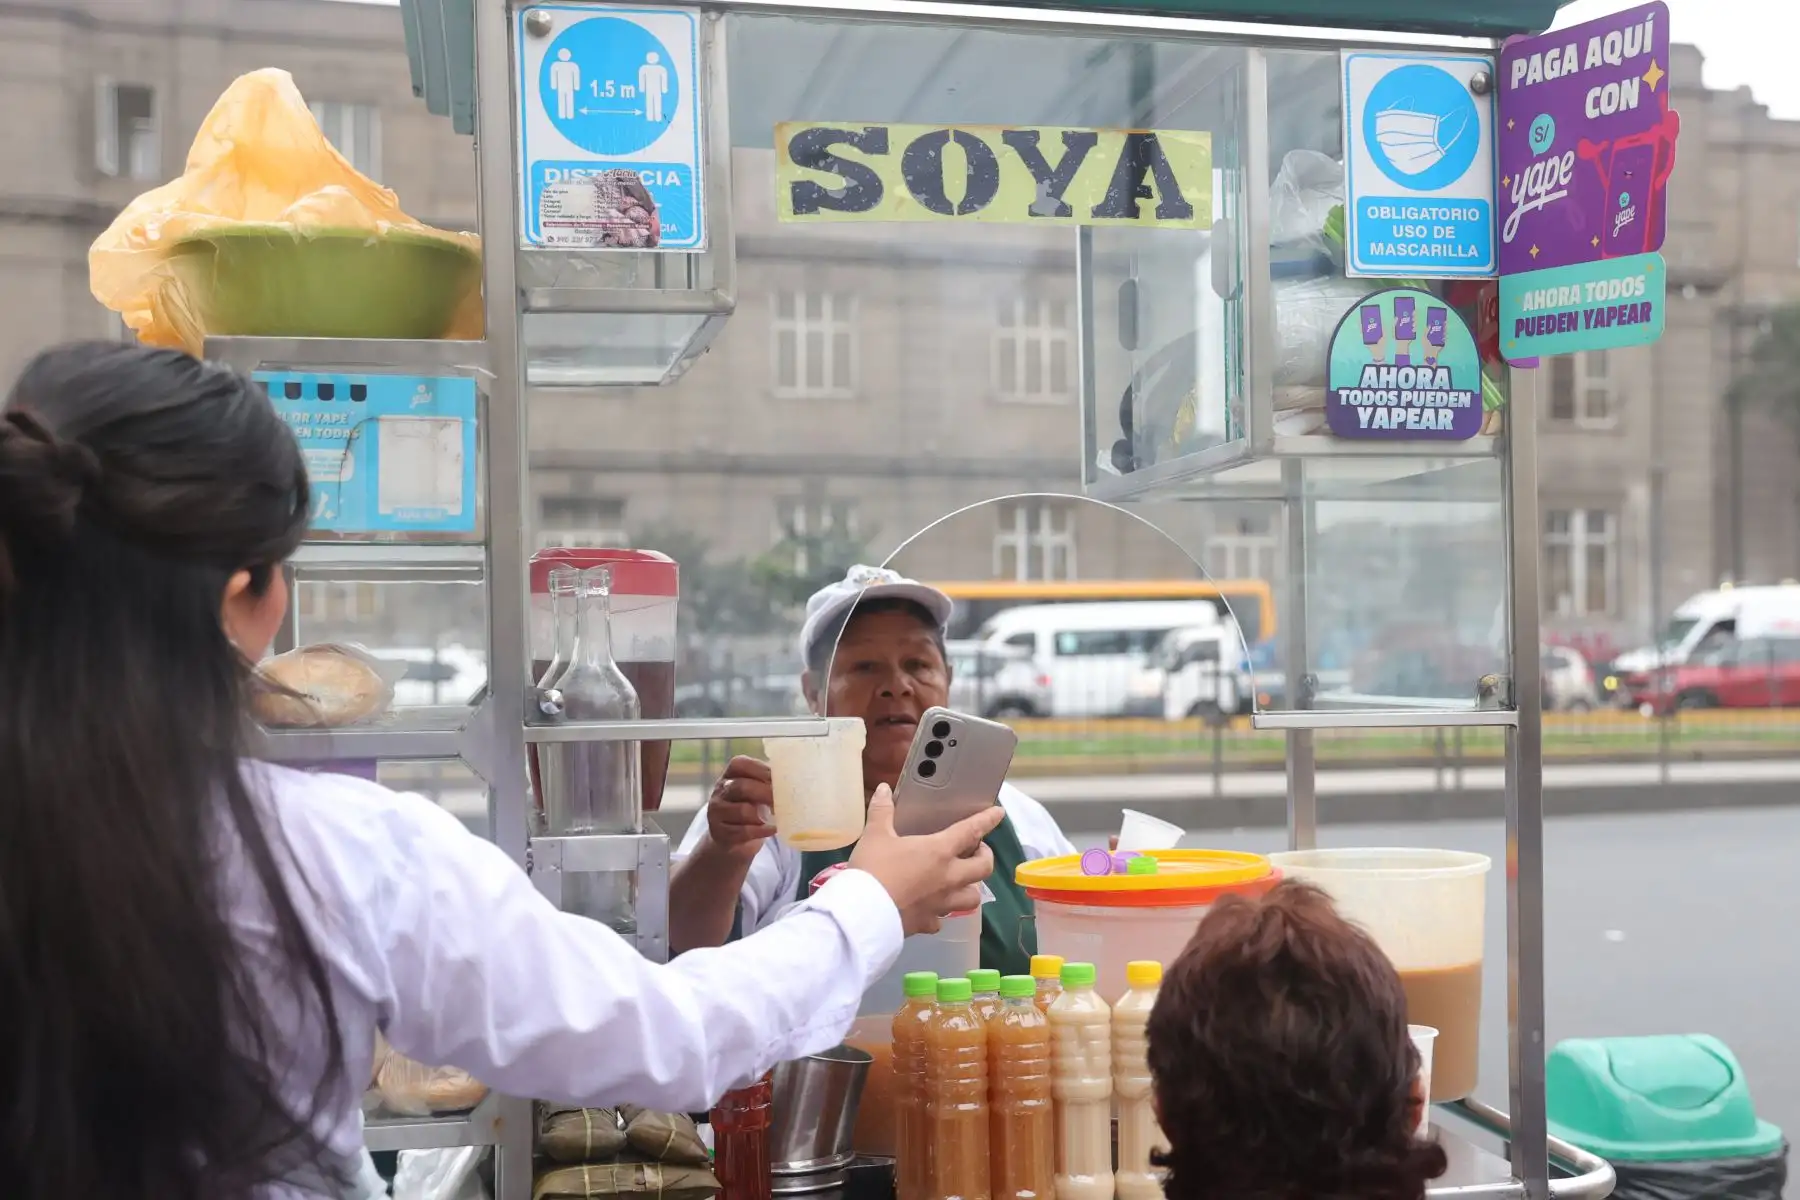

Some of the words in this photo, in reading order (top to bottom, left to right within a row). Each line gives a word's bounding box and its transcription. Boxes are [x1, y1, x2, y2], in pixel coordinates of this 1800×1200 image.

[1511, 43, 1579, 90] PAGA
[1584, 11, 1655, 70] AQUÍ
[590, 79, 616, 98] 1.5
[620, 84, 635, 98] m
[1585, 76, 1640, 119] CON
[1534, 124, 1549, 143] S/
[788, 126, 1194, 219] SOYA
[1502, 150, 1575, 243] yape
[1367, 206, 1480, 221] OBLIGATORIO
[1612, 205, 1636, 238] yape
[1392, 224, 1427, 239] USO
[1433, 225, 1456, 239] DE
[1370, 242, 1479, 258] MASCARILLA
[1523, 283, 1581, 311] AHORA
[1585, 275, 1645, 303] TODOS
[1514, 310, 1579, 338] PUEDEN
[1583, 301, 1652, 330] YAPEAR
[1360, 366, 1449, 390] AHORA
[1339, 389, 1398, 406] TODOS
[1401, 390, 1471, 408] PUEDEN
[1357, 407, 1454, 430] YAPEAR
